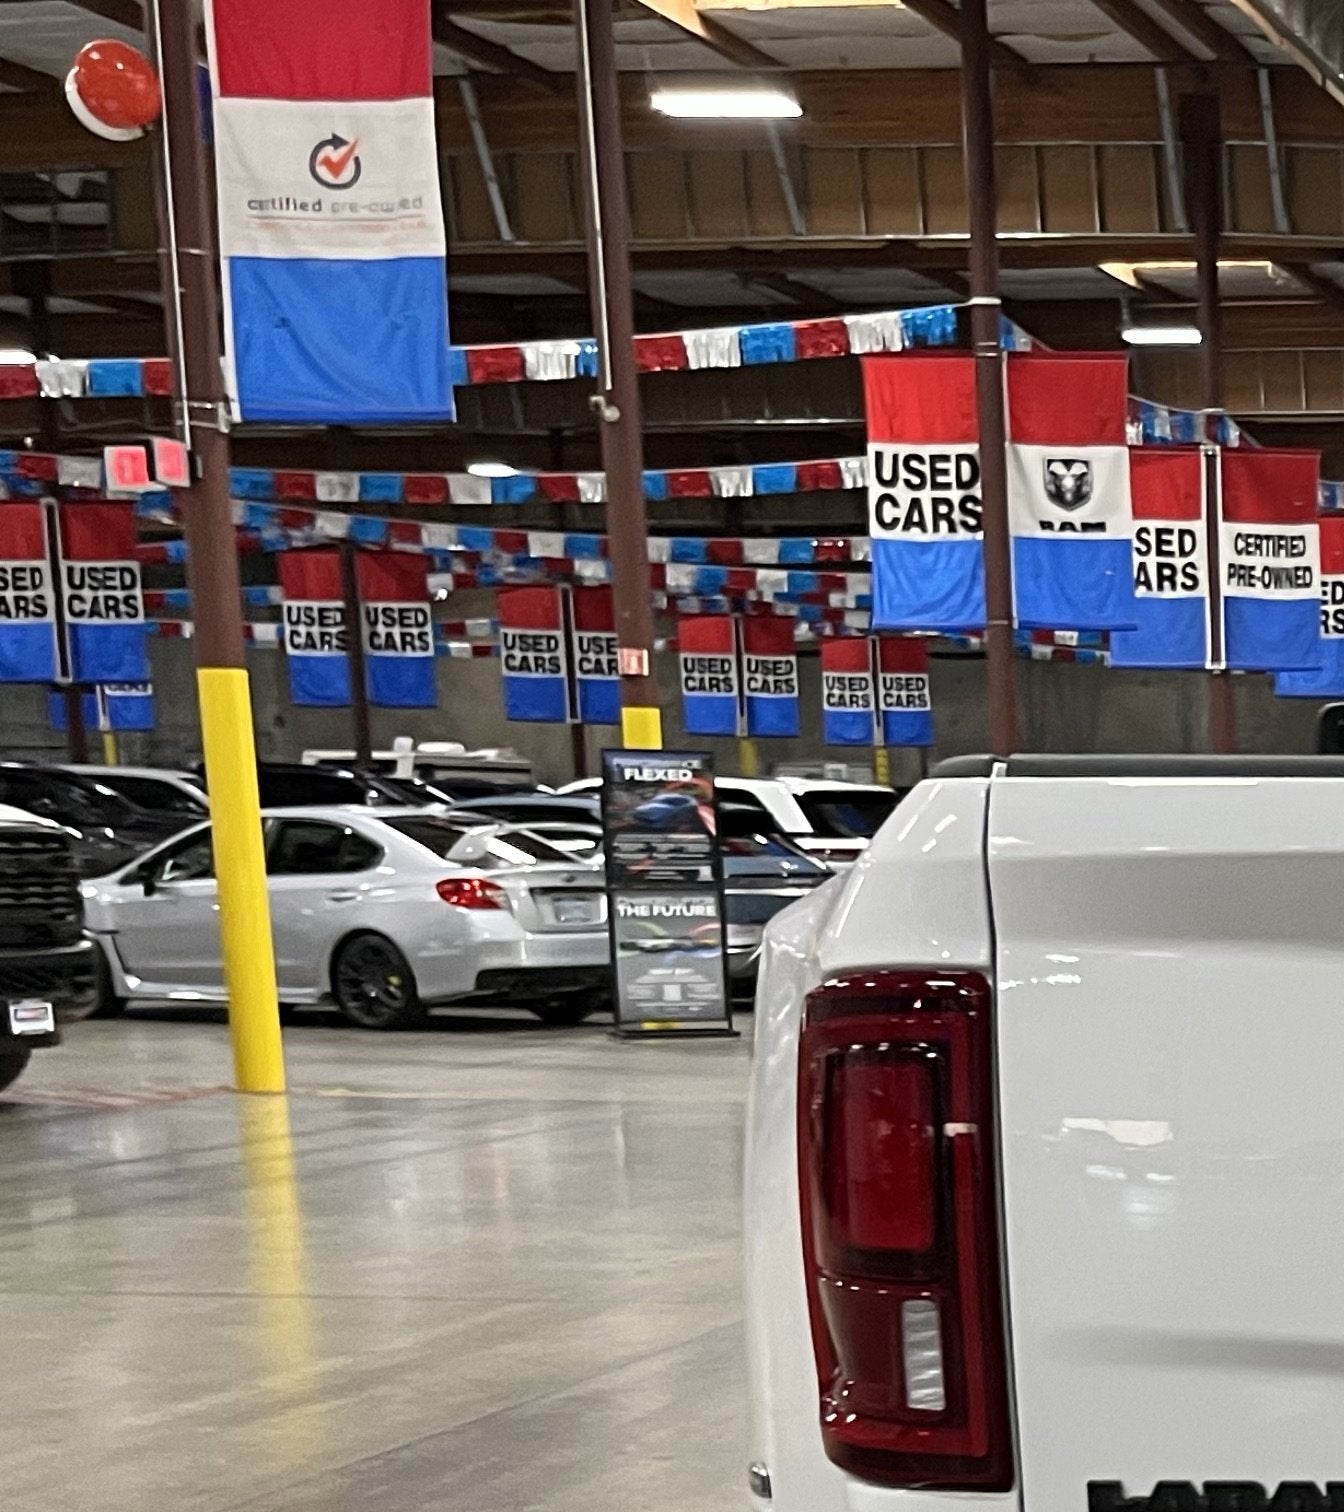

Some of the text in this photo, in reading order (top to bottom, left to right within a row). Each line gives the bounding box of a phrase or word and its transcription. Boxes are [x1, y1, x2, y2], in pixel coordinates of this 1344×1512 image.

[875, 451, 980, 491] USED
[875, 493, 982, 533] CARS
[1235, 533, 1306, 557] CERTIFIED
[66, 566, 137, 590] USED
[67, 594, 139, 618] CARS
[287, 606, 344, 627] USED
[366, 606, 428, 628] USED
[289, 630, 348, 651] CARS
[369, 631, 430, 652] CARS
[503, 632, 559, 653] USED
[504, 653, 561, 674] CARS
[684, 657, 732, 674] USED
[747, 658, 794, 675] USED
[684, 676, 734, 693] CARS
[746, 676, 796, 694] CARS
[826, 676, 869, 692] USED
[882, 676, 926, 692] USED
[826, 693, 870, 708] CARS
[883, 693, 928, 708] CARS
